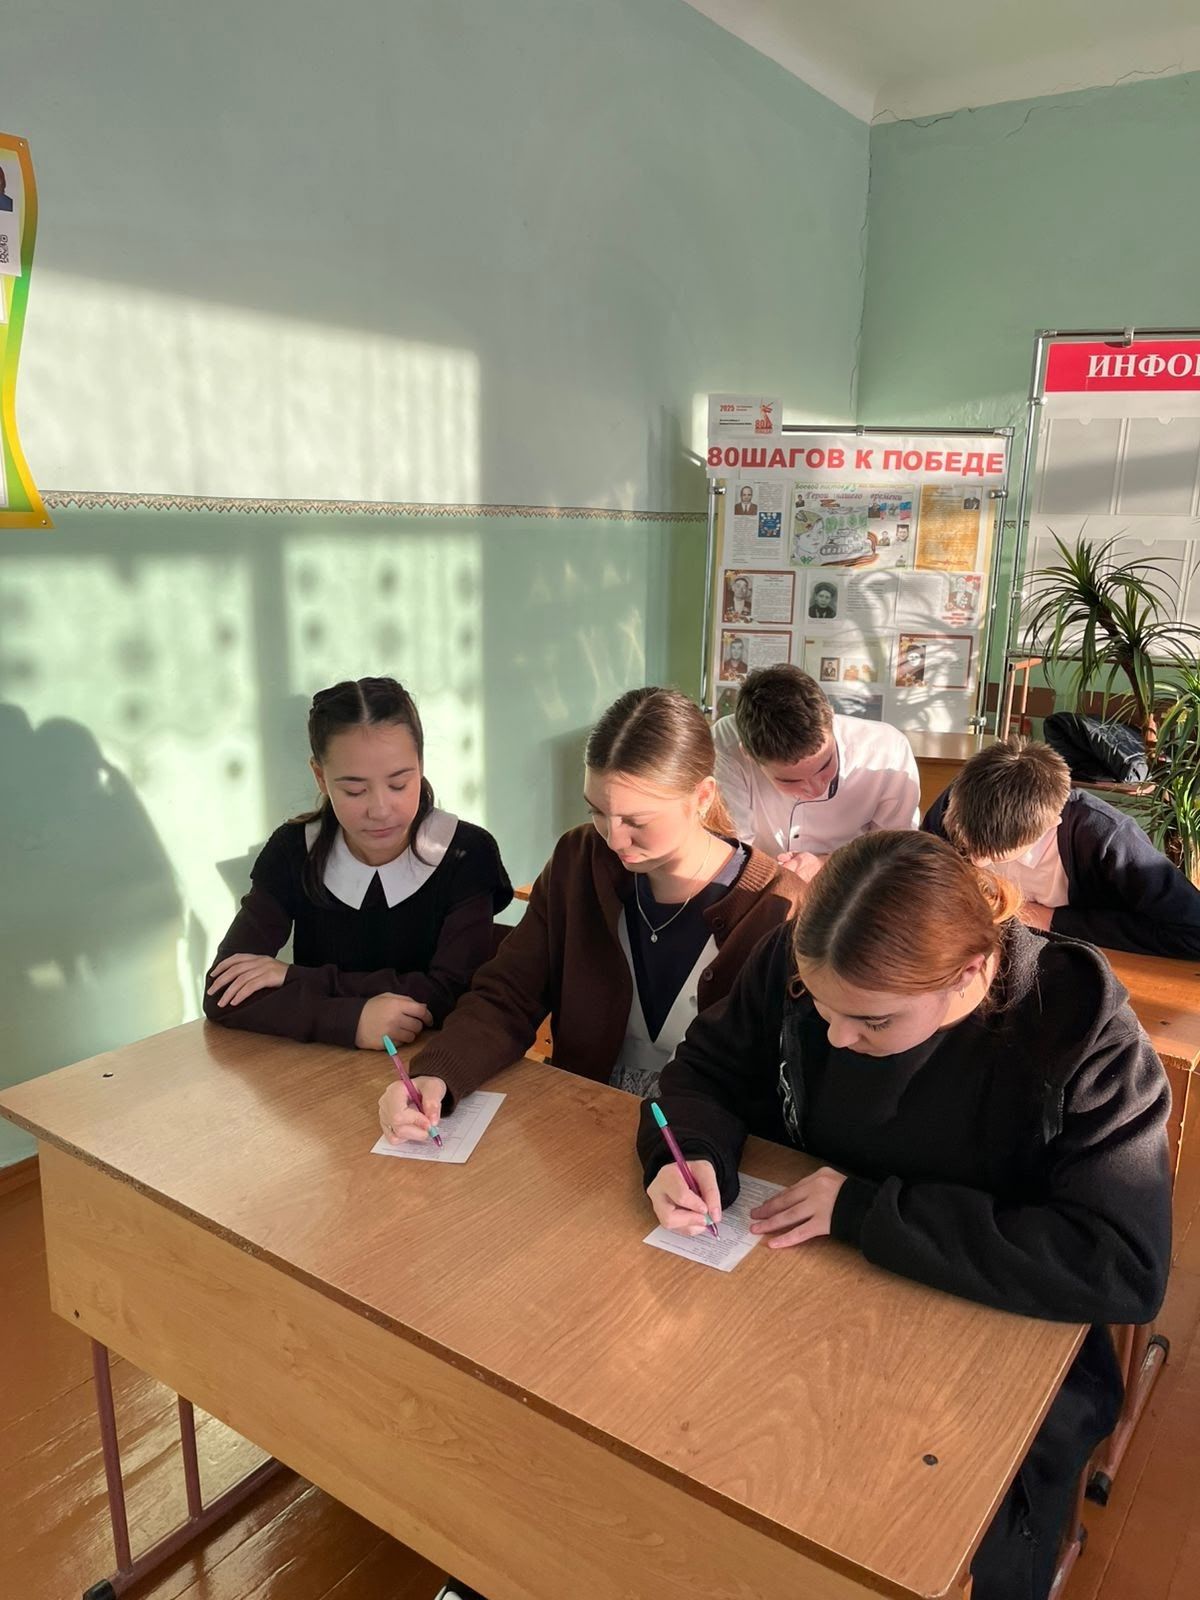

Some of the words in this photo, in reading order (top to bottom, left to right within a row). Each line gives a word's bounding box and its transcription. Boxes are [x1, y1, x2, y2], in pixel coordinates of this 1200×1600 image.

[707, 446, 845, 469] 80ШАГОВ
[855, 449, 874, 470] К
[882, 450, 1004, 477] ПОБЕДЕ
